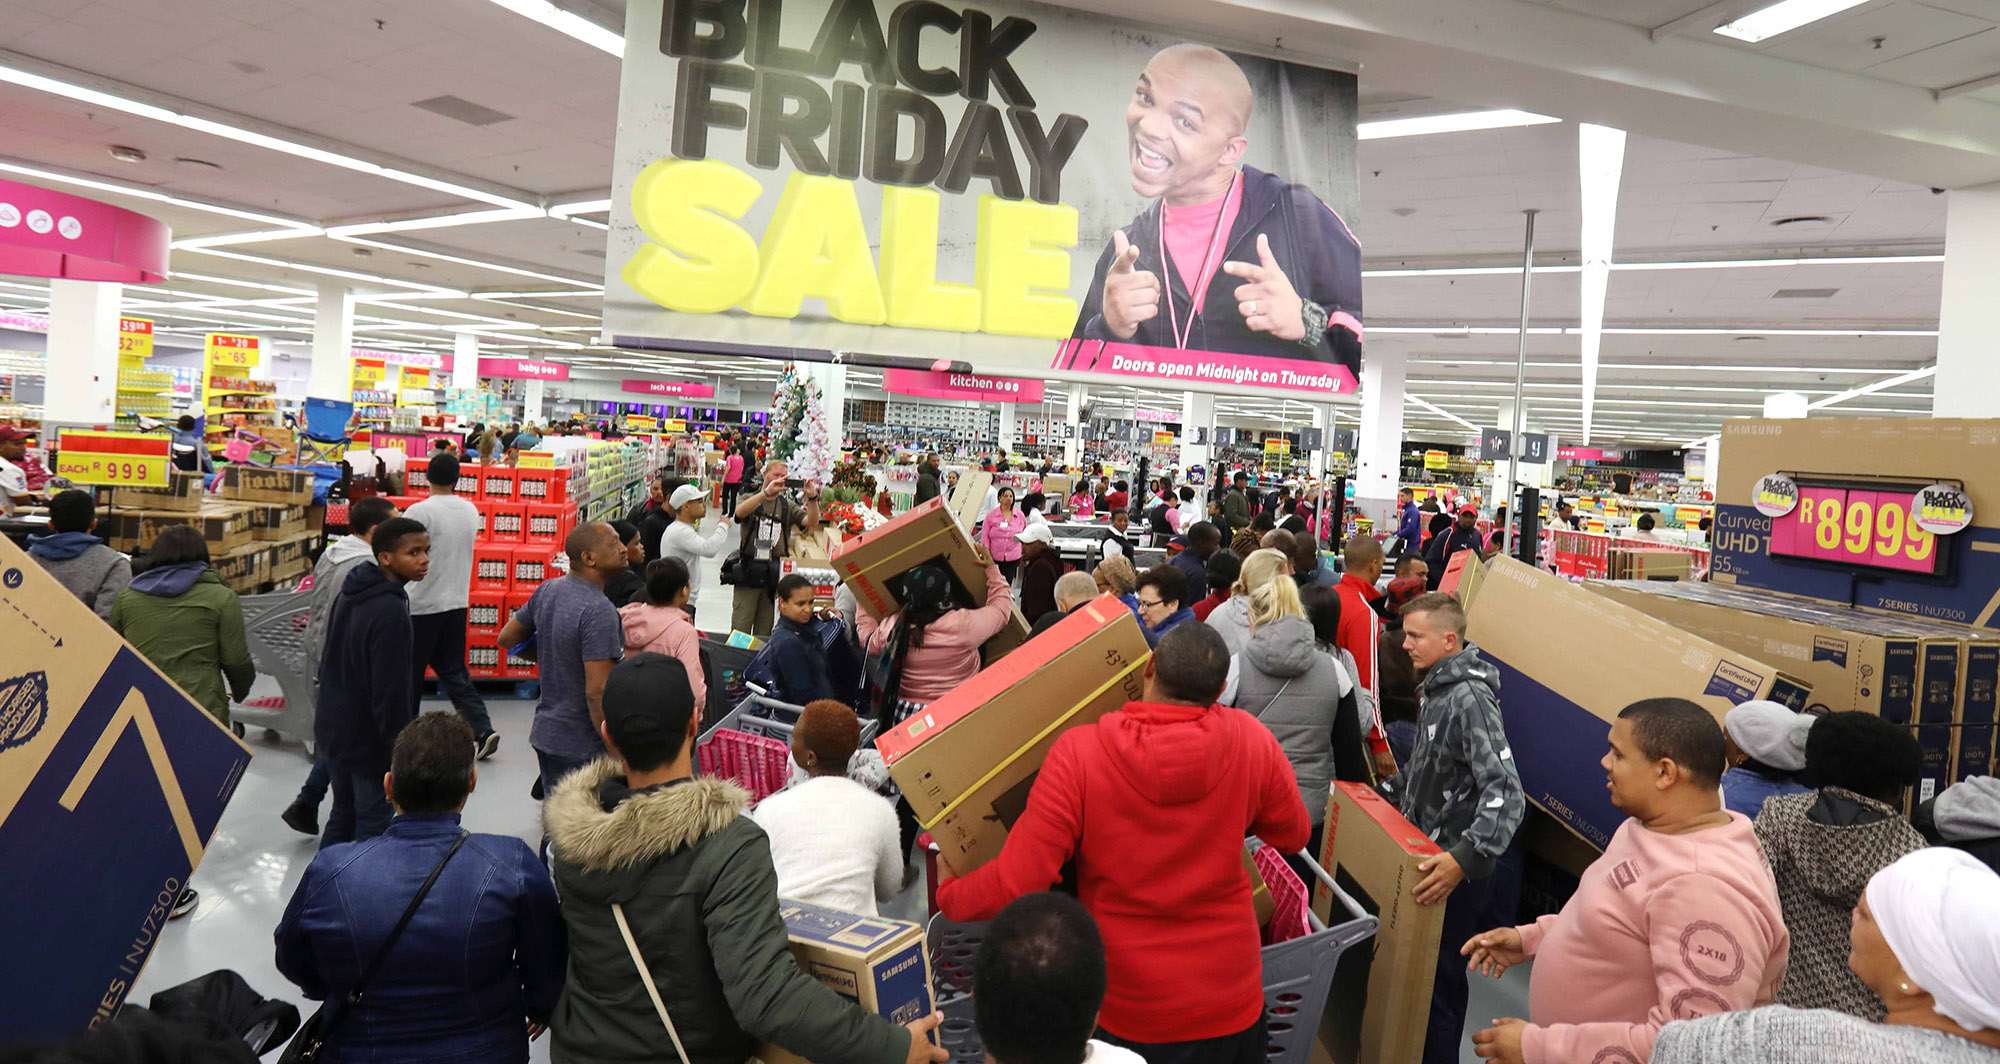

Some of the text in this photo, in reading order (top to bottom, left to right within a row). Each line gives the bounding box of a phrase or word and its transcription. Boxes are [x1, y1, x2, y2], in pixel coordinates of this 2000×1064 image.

[659, 0, 1037, 109] BLACK
[670, 57, 1089, 205] FRIDAY
[621, 156, 1080, 340] SALE
[518, 362, 540, 375] baby
[1112, 354, 1342, 392] Doors open Midnight on Thursday
[650, 384, 665, 392] tech
[950, 374, 993, 390] kitchen
[1726, 424, 1782, 436] SAMSUNG
[59, 462, 147, 480] EACH R 999
[1763, 484, 1794, 496] FRIDAY
[1764, 478, 1792, 488] BLACK
[1760, 491, 1792, 506] SALE
[1924, 490, 1960, 502] BLACK
[1925, 498, 1966, 509] FRIDAY
[1718, 511, 1772, 532] Curved
[1921, 505, 1966, 522] SALE
[1716, 530, 1760, 554] UHD
[1714, 554, 1732, 572] 55
[1493, 561, 1540, 588] SAMSUNG
[1886, 599, 1918, 614] SERIES
[1924, 605, 1966, 621] NU7300
[1720, 666, 1744, 682] Certified
[1542, 792, 1608, 846] 7 SERIES NU7300
[125, 876, 180, 966] NU7300
[1697, 944, 1727, 962] 2X18
[881, 954, 918, 982] SAMSUNG
